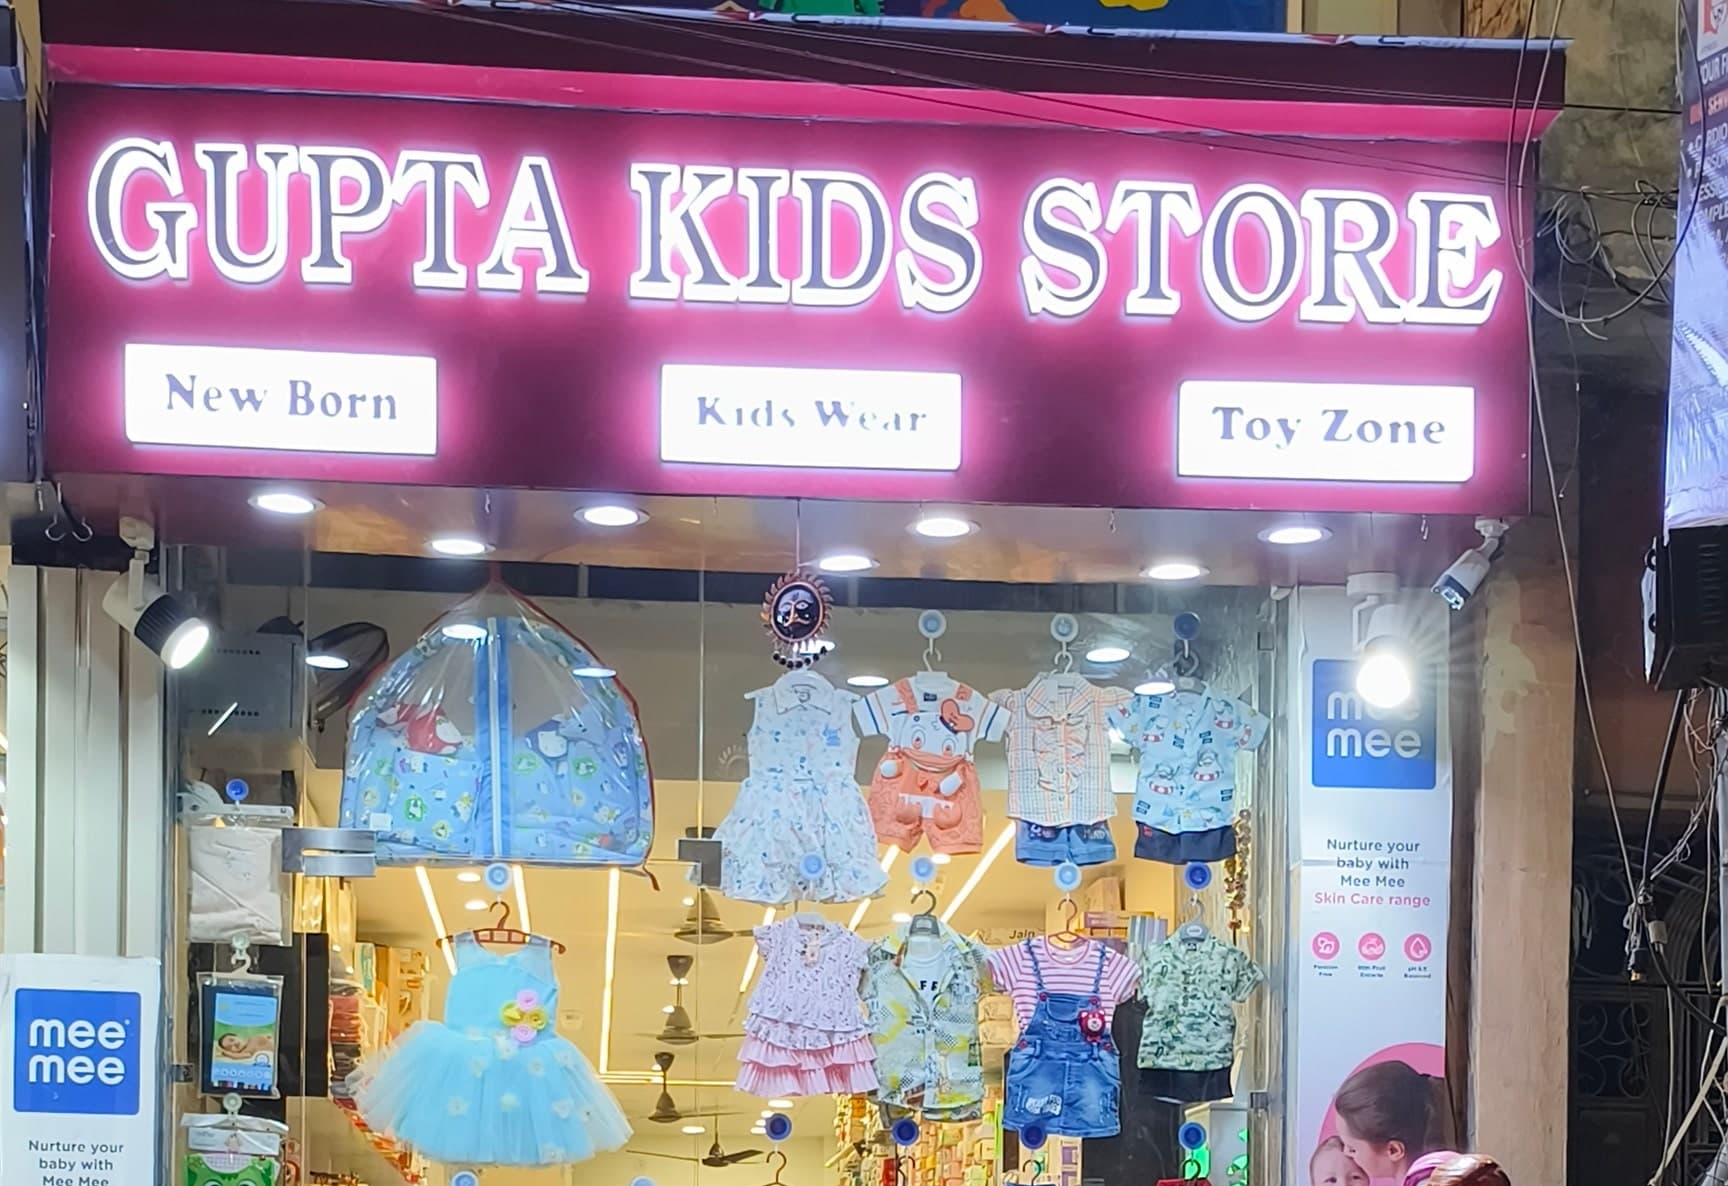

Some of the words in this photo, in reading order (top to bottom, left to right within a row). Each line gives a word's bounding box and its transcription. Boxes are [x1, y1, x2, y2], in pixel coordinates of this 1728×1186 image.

[87, 137, 590, 294] GUPTA
[628, 163, 983, 314] KIDS
[1020, 177, 1504, 327] STORE
[165, 373, 268, 412] New
[288, 379, 397, 420] Born
[697, 396, 796, 427] Kids
[1211, 406, 1302, 449] Toy
[1321, 409, 1446, 444] Zone
[1327, 728, 1422, 758] mee
[1327, 839, 1383, 851] Nurture
[1387, 841, 1421, 854] your
[1336, 857, 1373, 871] baby
[1378, 858, 1409, 870] with
[1340, 874, 1371, 887] Mee
[1375, 875, 1405, 888] Mee
[1314, 891, 1346, 905] Skin
[1350, 892, 1384, 905] Care
[1388, 895, 1431, 909] range
[28, 1018, 126, 1049] mee
[28, 1055, 126, 1086] mee
[28, 1139, 86, 1154] Nurture
[90, 1142, 125, 1157] your
[38, 1156, 77, 1171] baby
[81, 1158, 114, 1171] with
